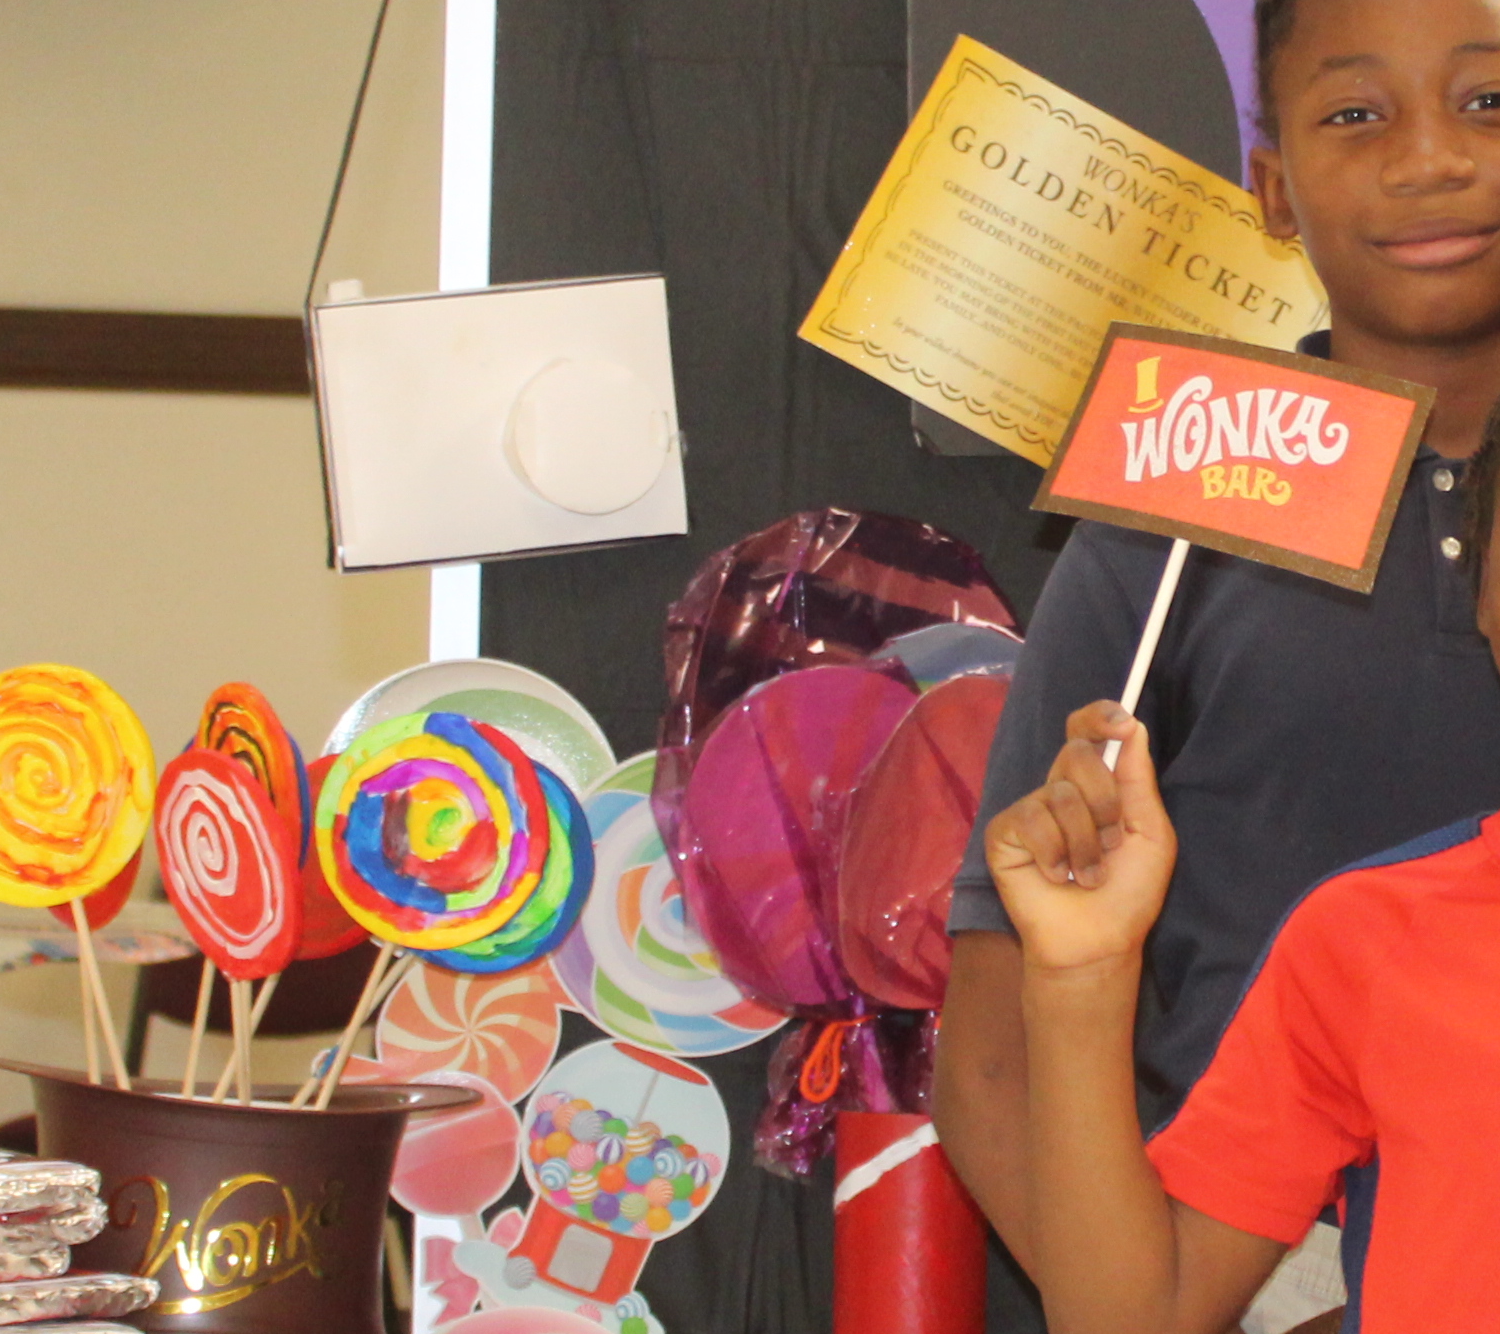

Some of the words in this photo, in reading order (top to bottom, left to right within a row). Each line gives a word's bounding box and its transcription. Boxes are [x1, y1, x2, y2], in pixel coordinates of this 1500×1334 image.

[940, 178, 1019, 228] GREETINGS
[1017, 219, 1040, 240] TO
[950, 124, 1129, 241] GOLDEN
[1140, 226, 1293, 328] TICKET
[1081, 152, 1202, 238] WONKA'S
[955, 207, 1017, 248] GOLDEN
[1014, 239, 1066, 275] TICKET
[1121, 373, 1349, 482] WONKA
[1199, 464, 1292, 507] BAR
